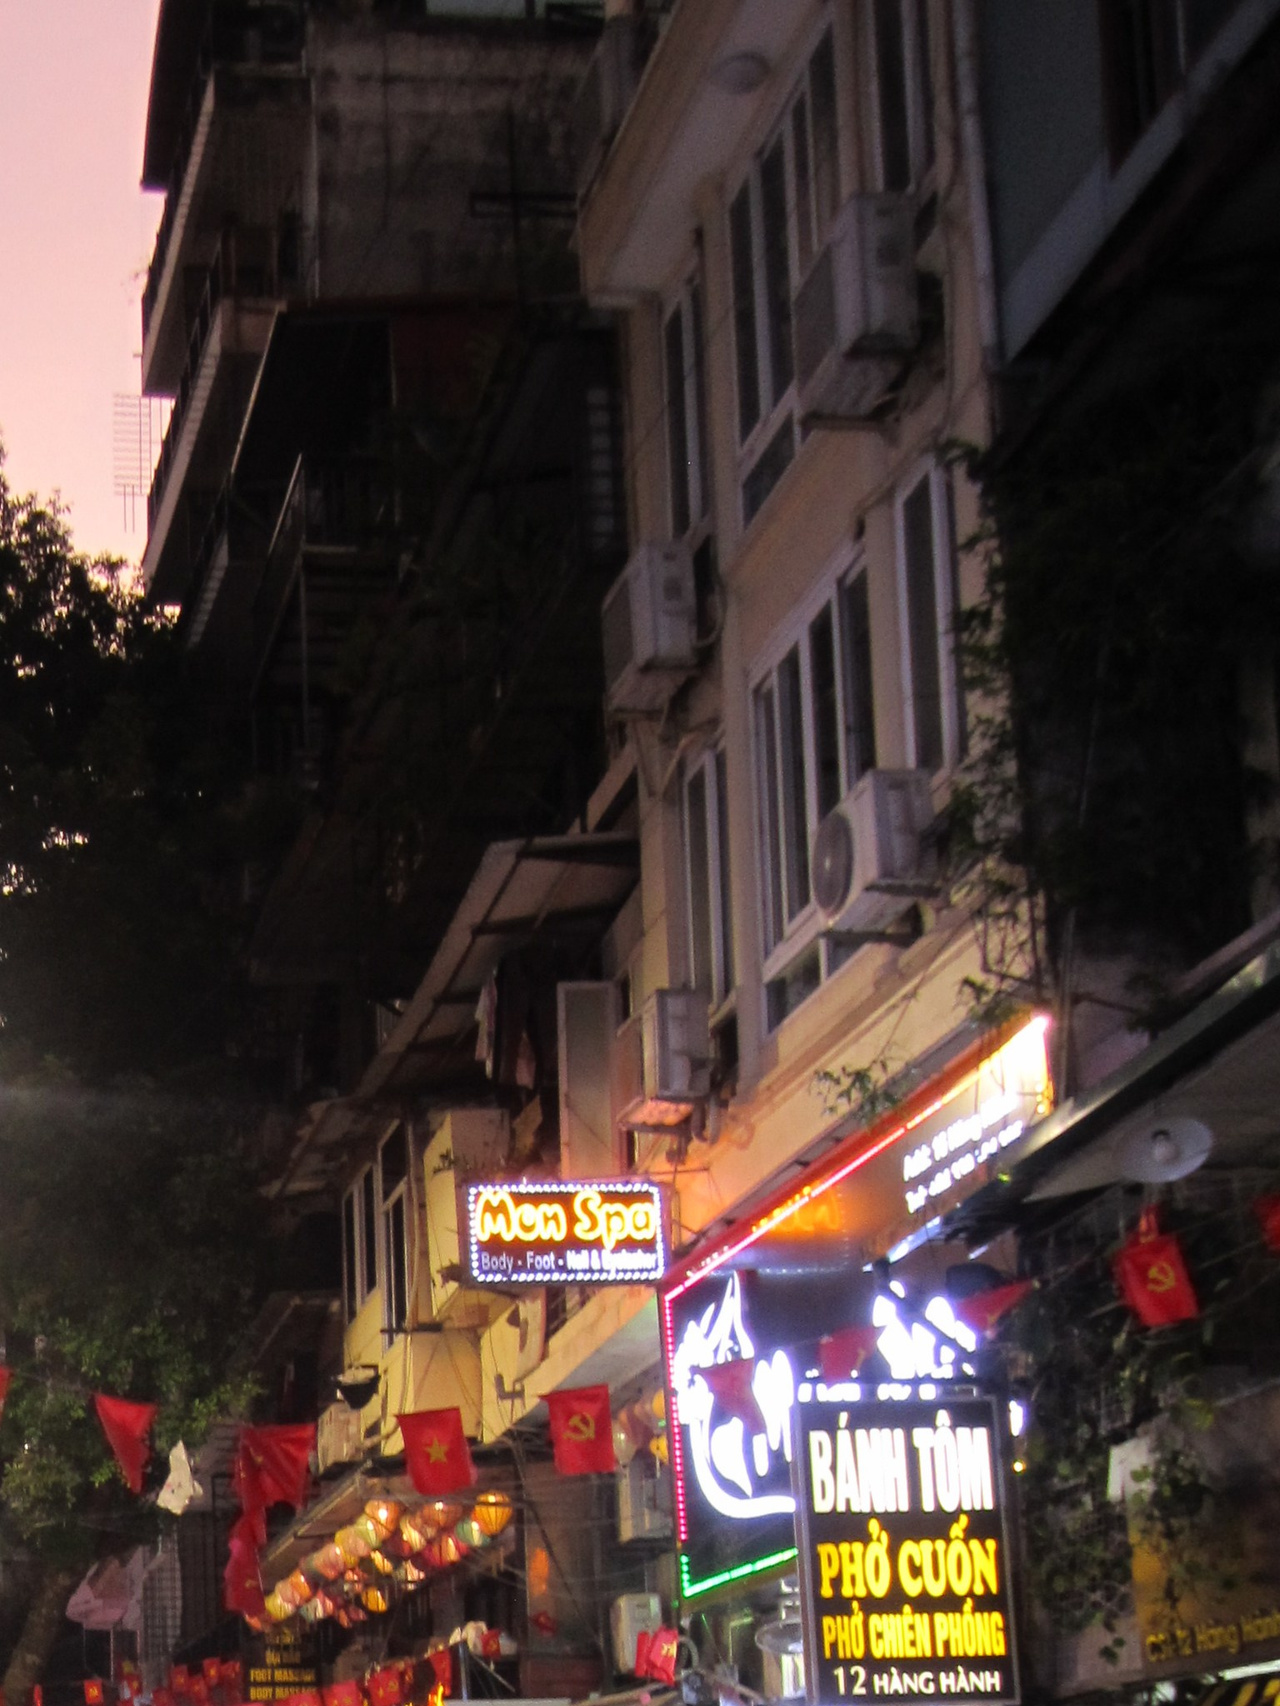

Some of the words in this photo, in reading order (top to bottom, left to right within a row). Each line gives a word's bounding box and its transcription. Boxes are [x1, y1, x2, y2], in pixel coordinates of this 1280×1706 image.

[573, 1190, 658, 1250] Spa
[481, 1251, 514, 1273] Body
[526, 1251, 555, 1269] Foot
[809, 1411, 910, 1513] BÁNH
[912, 1409, 994, 1512] TÔM
[817, 1518, 891, 1598] PHỞ
[898, 1513, 998, 1597] CUỐN
[822, 1600, 866, 1659] PHỞ
[869, 1604, 932, 1659] CHIÊN
[834, 1665, 867, 1696] 12
[873, 1667, 934, 1695] HÀNG
[939, 1665, 1002, 1694] HÀNH
